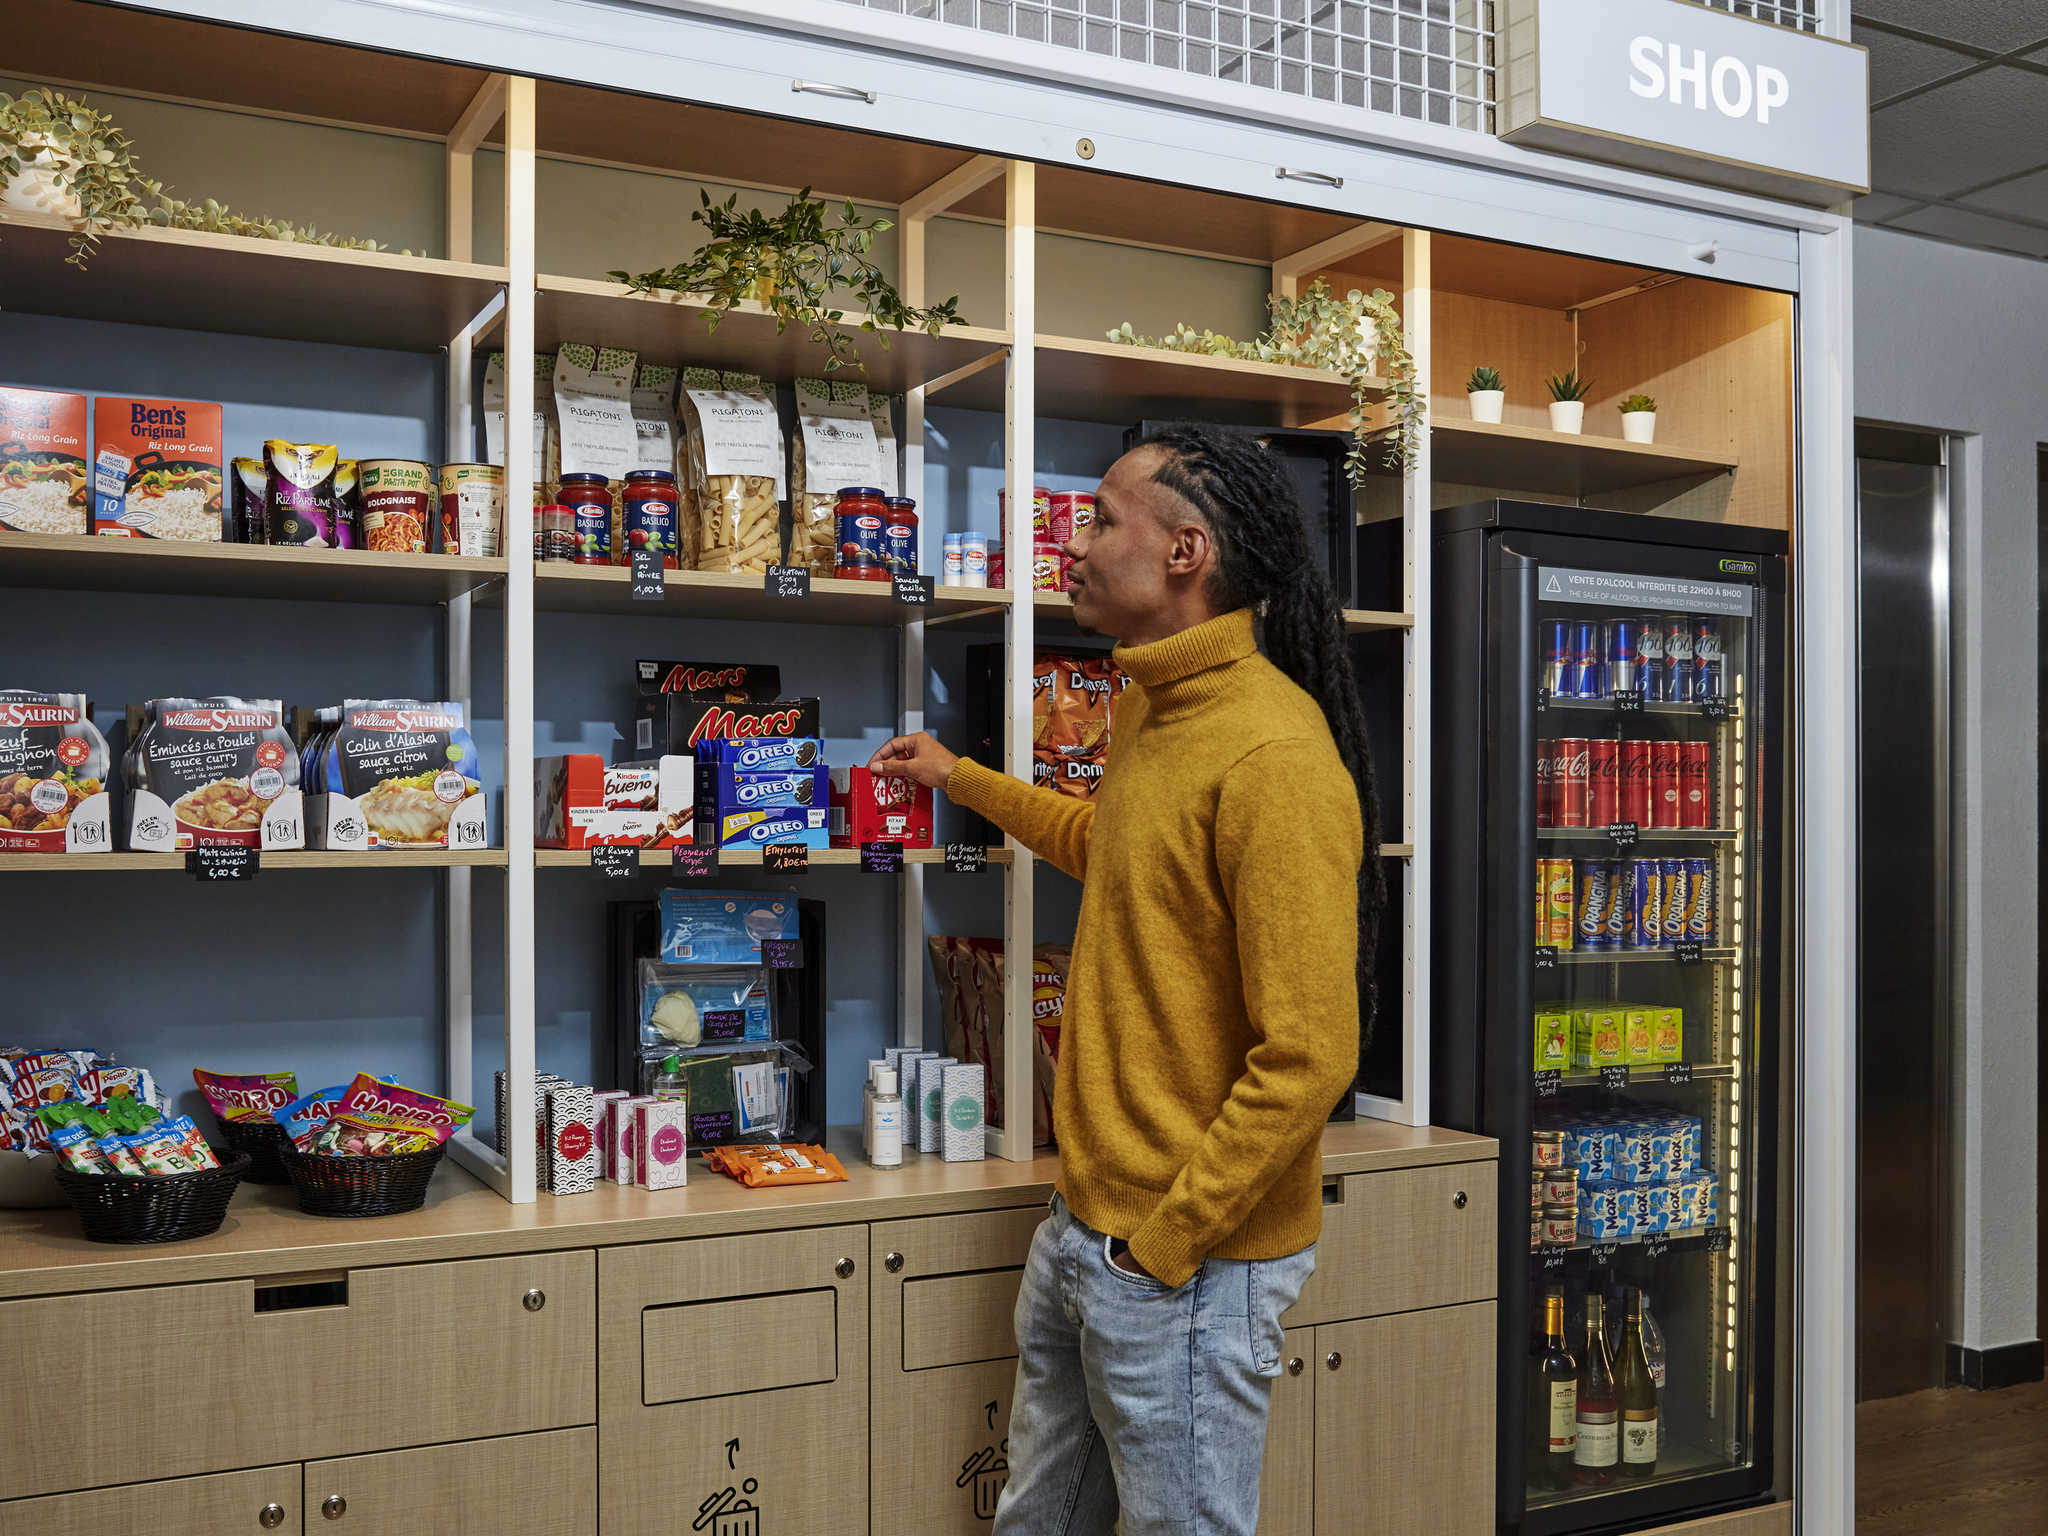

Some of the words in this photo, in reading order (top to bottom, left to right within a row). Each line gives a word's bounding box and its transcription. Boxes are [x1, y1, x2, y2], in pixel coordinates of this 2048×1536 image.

[1629, 35, 1789, 124] SHOP
[131, 403, 186, 425] Ben's
[570, 406, 623, 421] RIGATONI
[711, 407, 764, 417] RIGATONI
[130, 424, 186, 440] Original
[636, 421, 667, 432] ATONI
[814, 428, 864, 440] RIGATONI
[27, 432, 51, 445] Long
[53, 434, 78, 446] Grain
[149, 442, 162, 451] Riz
[164, 443, 186, 454] Long
[188, 444, 214, 453] Grain
[390, 468, 423, 479] GRAND
[103, 499, 119, 512] 10
[367, 496, 417, 508] BOLOGNAISE
[577, 519, 605, 529] BASILICO
[641, 516, 670, 527] BASILICO
[860, 530, 878, 540] OLIVE
[891, 538, 908, 548] OLIVE
[1568, 575, 1595, 585] VENTE
[1596, 577, 1636, 590] D'ALCOOL
[1637, 581, 1676, 593] INTERDITE
[1677, 584, 1688, 594] DE
[1715, 586, 1721, 597] À
[660, 664, 747, 694] Mars
[8, 703, 75, 727] SAURIN
[165, 712, 212, 727] William
[210, 709, 272, 732] SAURIN
[353, 714, 397, 727] William
[395, 710, 456, 732] SAURIN
[688, 706, 801, 748] Mars
[150, 737, 201, 758] Émincés
[203, 739, 216, 751] de
[217, 732, 256, 749] Poulet
[346, 738, 382, 754] Colin
[385, 732, 438, 749] d'Alaska
[0, 748, 57, 766] uignon
[170, 756, 203, 769] sauce
[206, 752, 238, 767] curry
[359, 756, 391, 769] sauce
[393, 749, 428, 764] citron
[742, 745, 794, 766] OREO
[375, 767, 384, 775] et
[402, 764, 414, 772] riz
[616, 772, 640, 780] Kinder
[605, 779, 652, 796] bueno
[739, 782, 793, 801] OREO
[622, 823, 642, 831] bueno
[751, 820, 803, 842] OREO
[1579, 870, 1607, 933] ORANGINA
[1662, 869, 1687, 933] ORANGINA
[1687, 869, 1712, 933] ORANGINA
[350, 1090, 451, 1126] HARIBO
